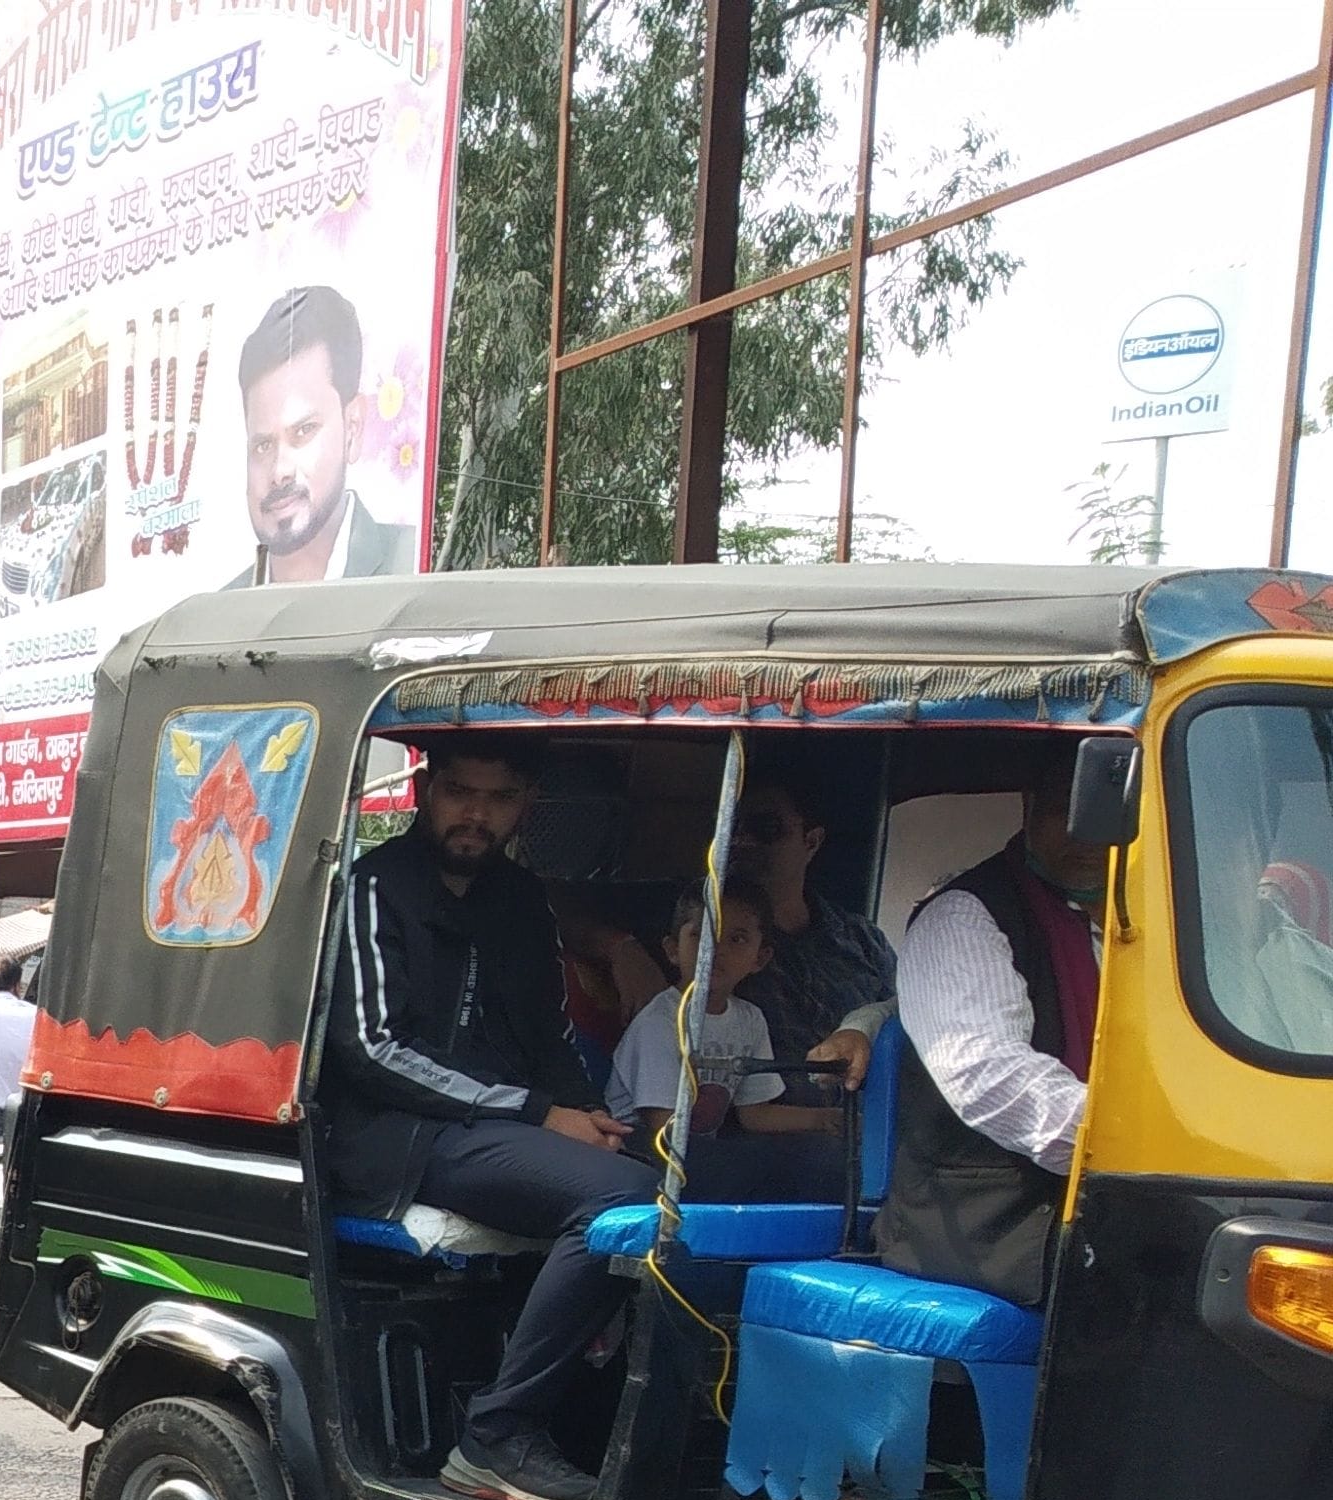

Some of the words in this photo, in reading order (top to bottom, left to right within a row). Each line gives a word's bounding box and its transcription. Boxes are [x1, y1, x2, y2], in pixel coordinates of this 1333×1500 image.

[17, 120, 80, 196] एण्ड
[88, 90, 151, 165] टेन्ट
[157, 40, 263, 138] हाउस
[0, 269, 38, 319] आदि
[184, 206, 203, 254] के
[1111, 394, 1219, 422] IndianOil
[12, 769, 65, 814] ललितपुर
